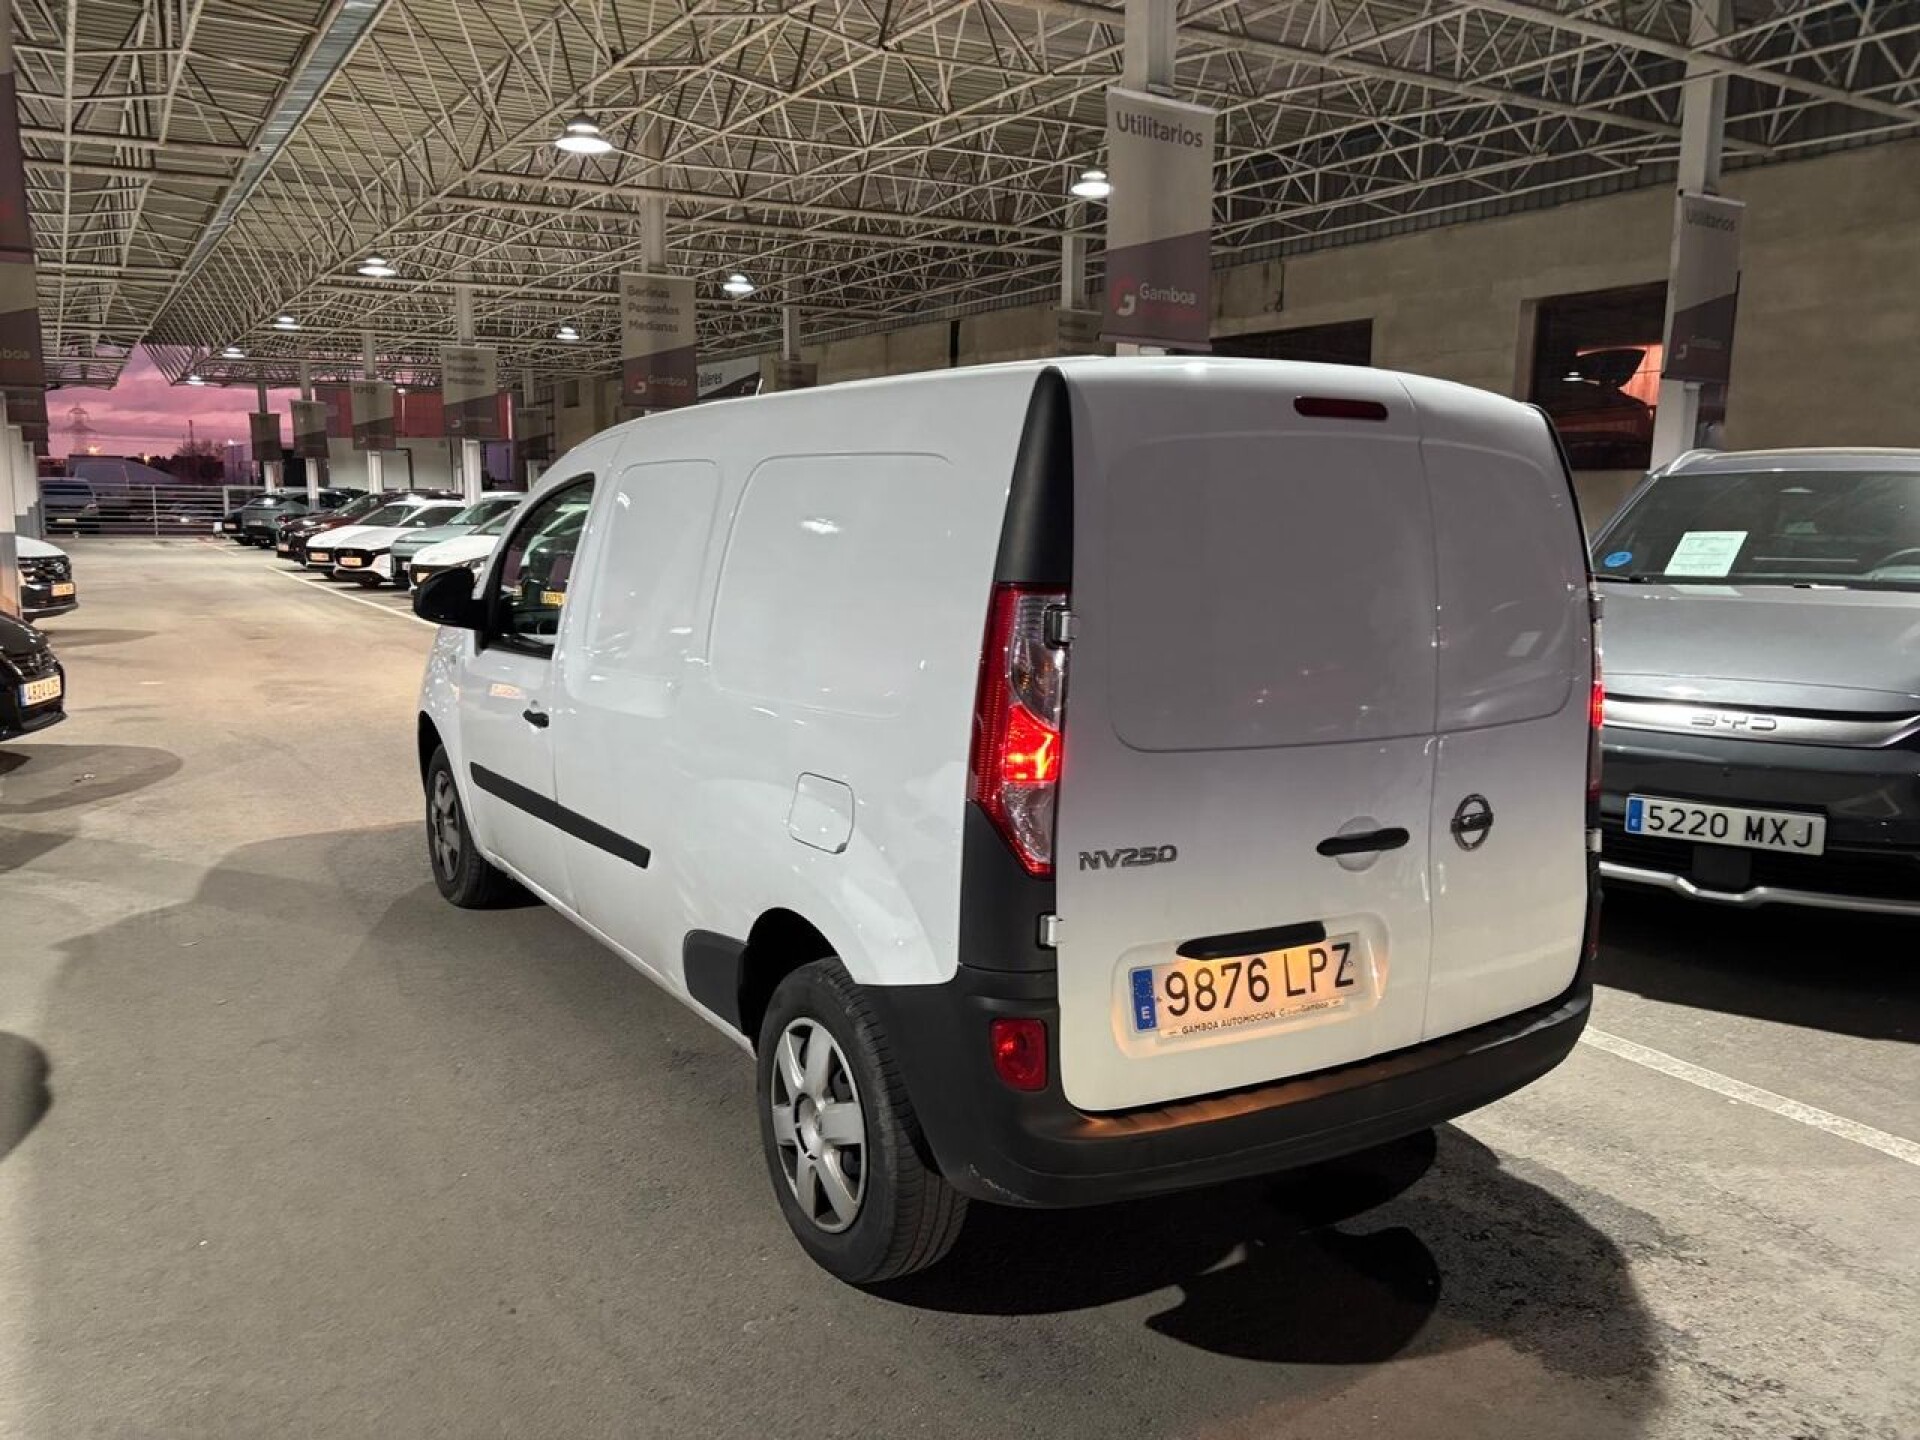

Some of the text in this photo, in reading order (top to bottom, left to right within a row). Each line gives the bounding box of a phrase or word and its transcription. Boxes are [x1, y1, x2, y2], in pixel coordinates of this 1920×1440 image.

[1116, 111, 1203, 148] Utilitarios
[1140, 282, 1196, 305] Gamboa
[1691, 714, 1777, 731] BYD
[1648, 805, 1813, 848] 5220 MXJ
[1079, 844, 1178, 871] NV250
[1165, 942, 1354, 1016] 9876 LPZ
[1181, 1020, 1219, 1034] GAMBOA
